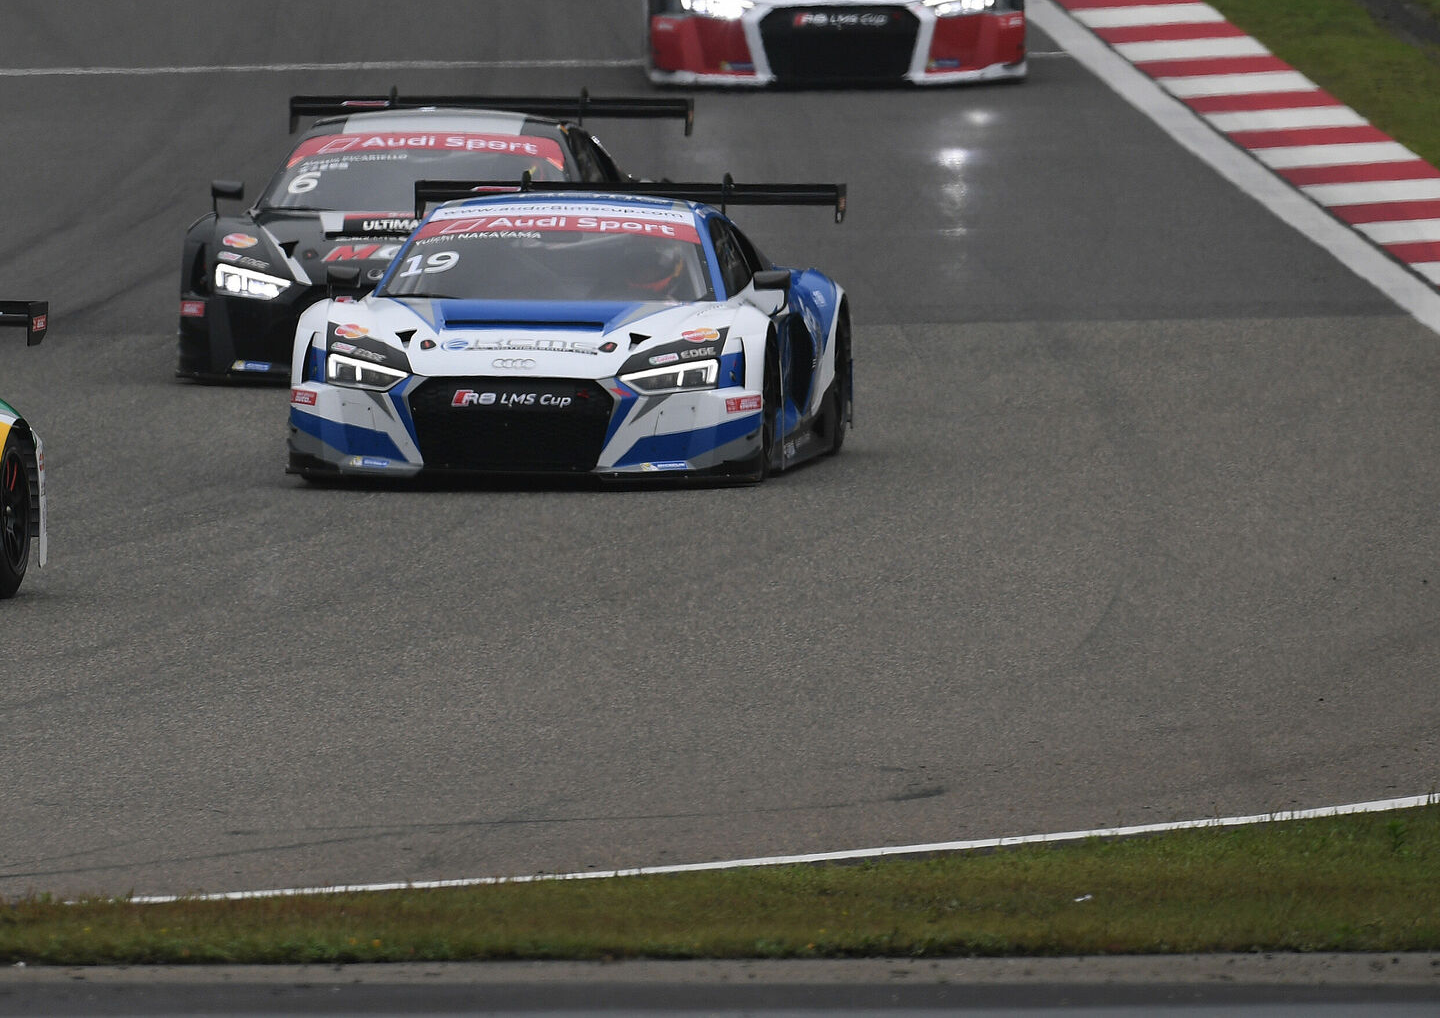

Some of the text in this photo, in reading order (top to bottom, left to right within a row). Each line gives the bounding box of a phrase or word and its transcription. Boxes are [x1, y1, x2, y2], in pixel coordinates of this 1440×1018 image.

[361, 135, 538, 155] Audi Sport
[287, 171, 321, 194] 6
[362, 219, 421, 231] ULTIMA
[486, 216, 675, 236] Audi Sport
[457, 230, 542, 240] NAKAYAMA
[399, 250, 460, 278] 19
[680, 347, 717, 359] EDGE
[457, 390, 572, 408] R8 LMS Cup
